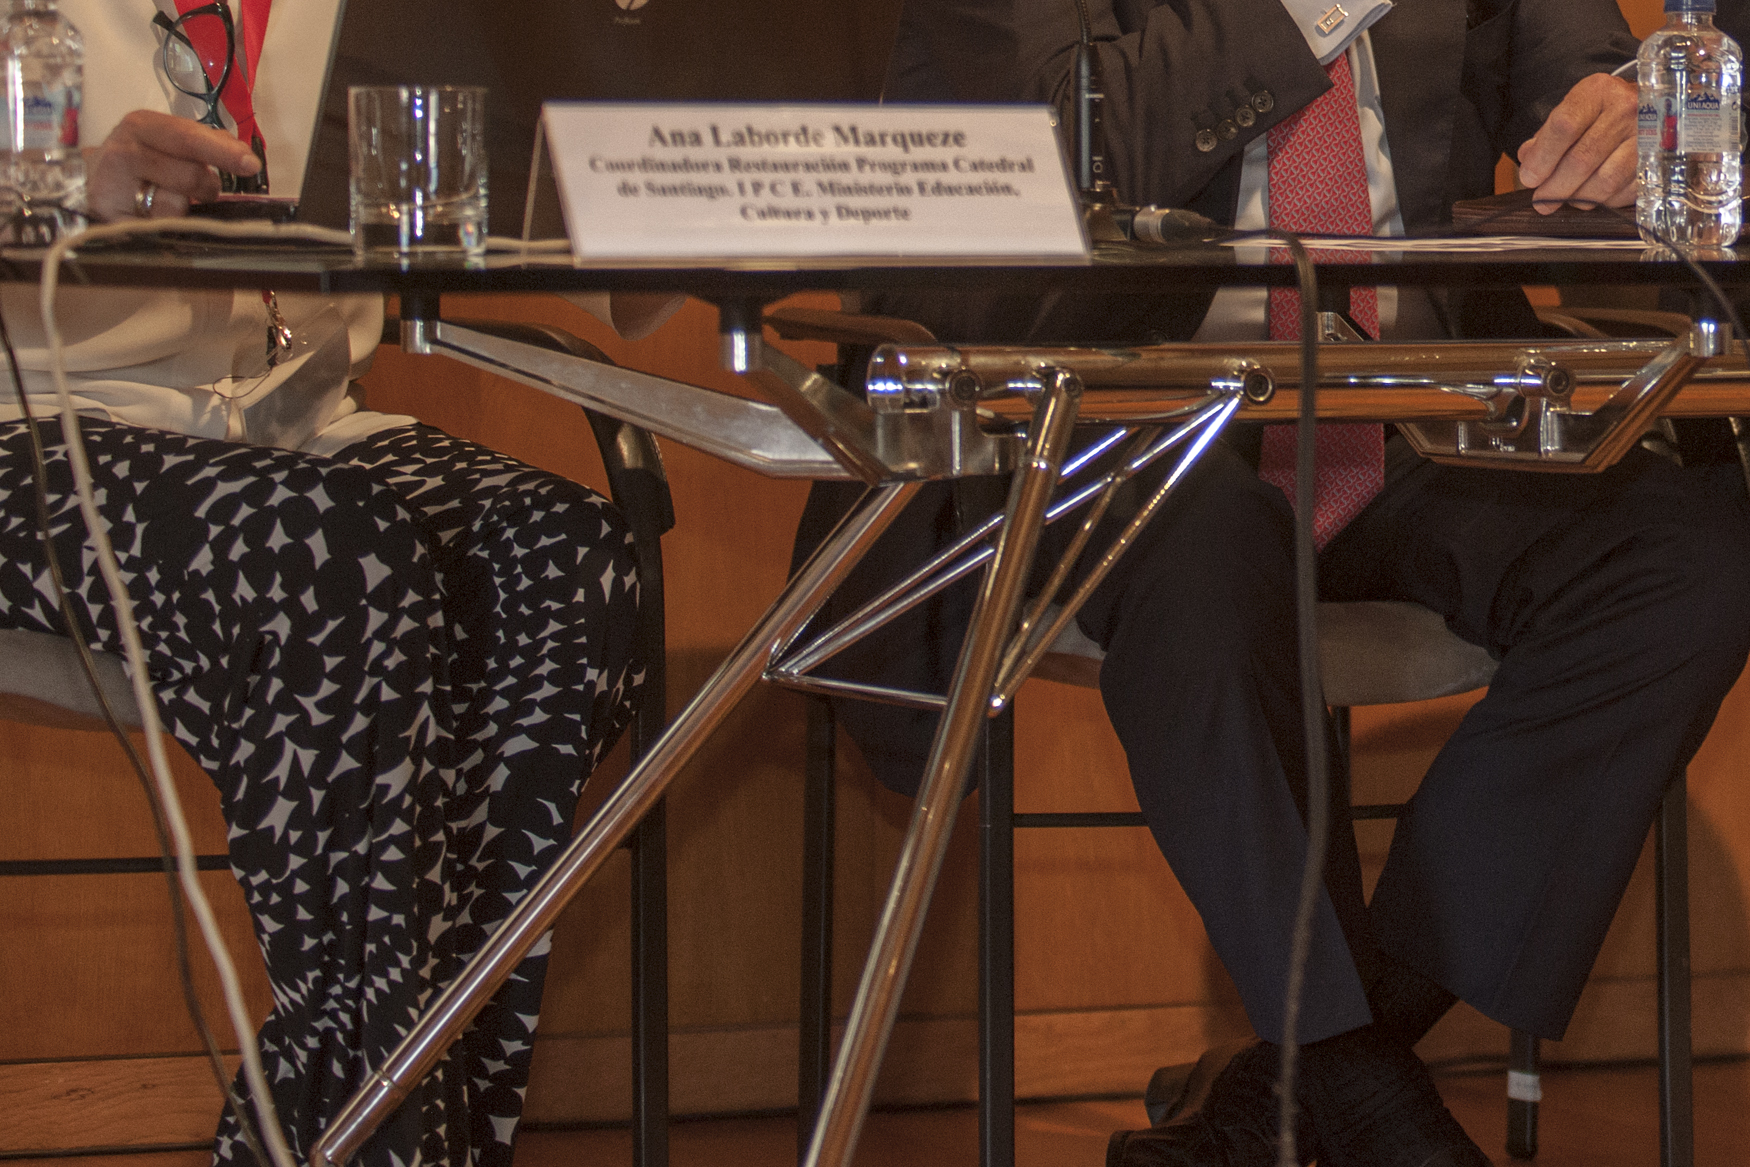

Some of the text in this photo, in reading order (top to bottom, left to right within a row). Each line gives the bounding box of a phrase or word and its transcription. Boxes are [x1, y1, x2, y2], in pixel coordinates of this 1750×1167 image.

[649, 123, 968, 154] Ana Laborde Marqueze
